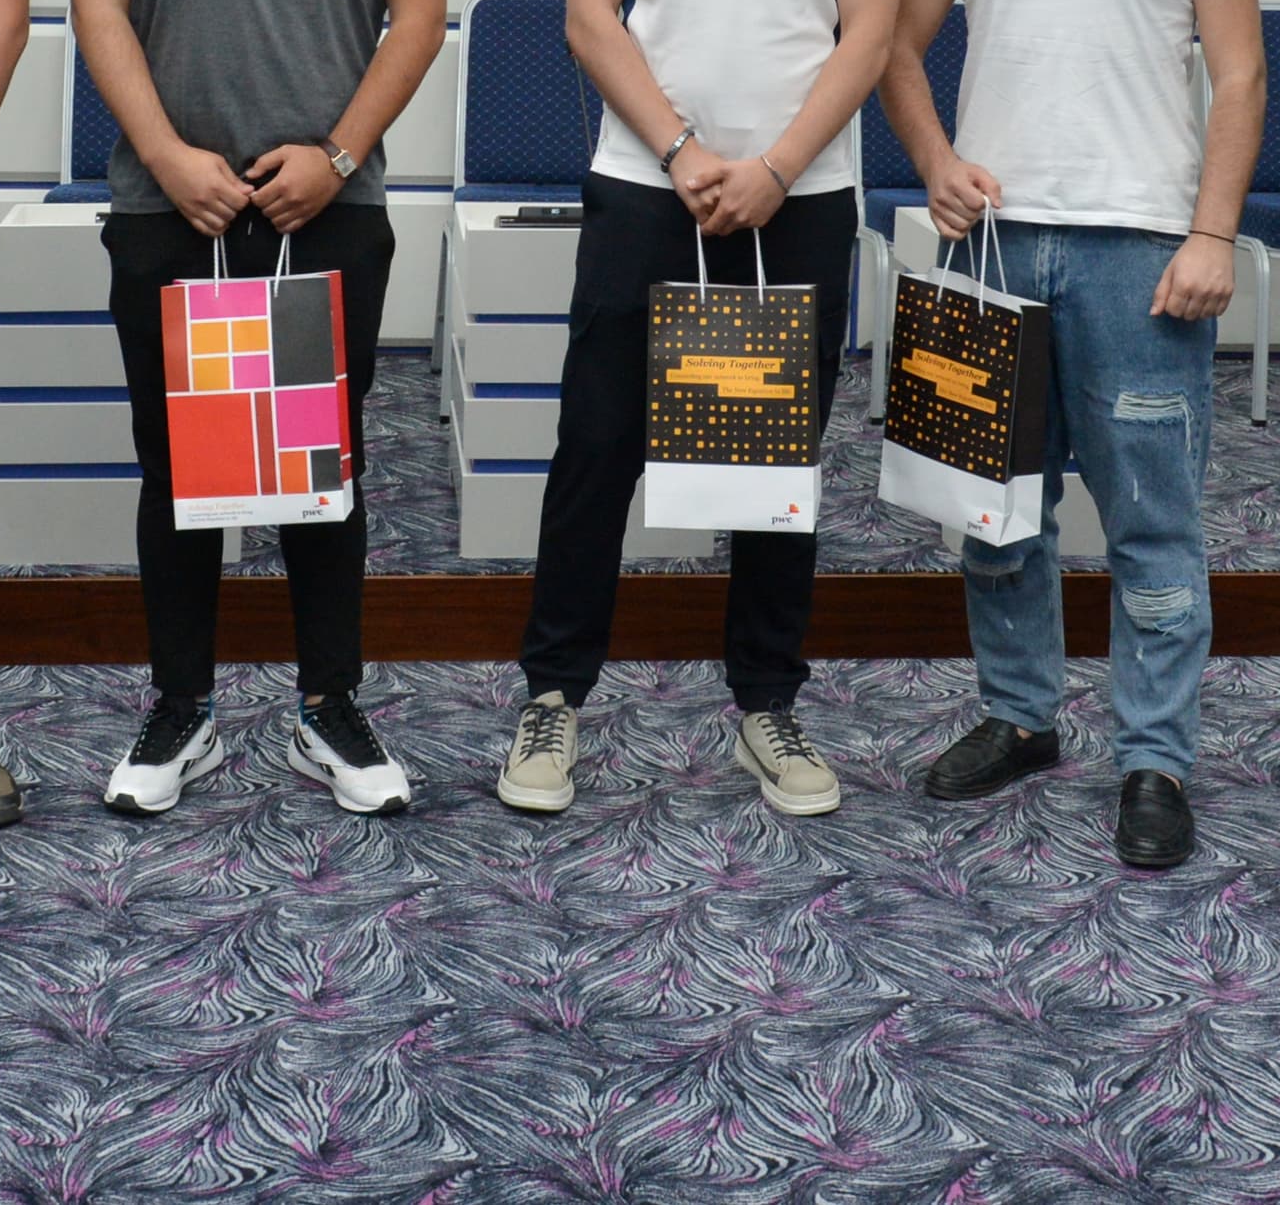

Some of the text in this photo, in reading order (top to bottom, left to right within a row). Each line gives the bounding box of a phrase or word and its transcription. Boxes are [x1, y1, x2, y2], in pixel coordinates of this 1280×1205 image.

[686, 358, 776, 370] Solving Together
[915, 352, 946, 369] Solving
[948, 362, 984, 380] Together
[302, 508, 323, 519] pwc
[772, 515, 793, 525] pwc
